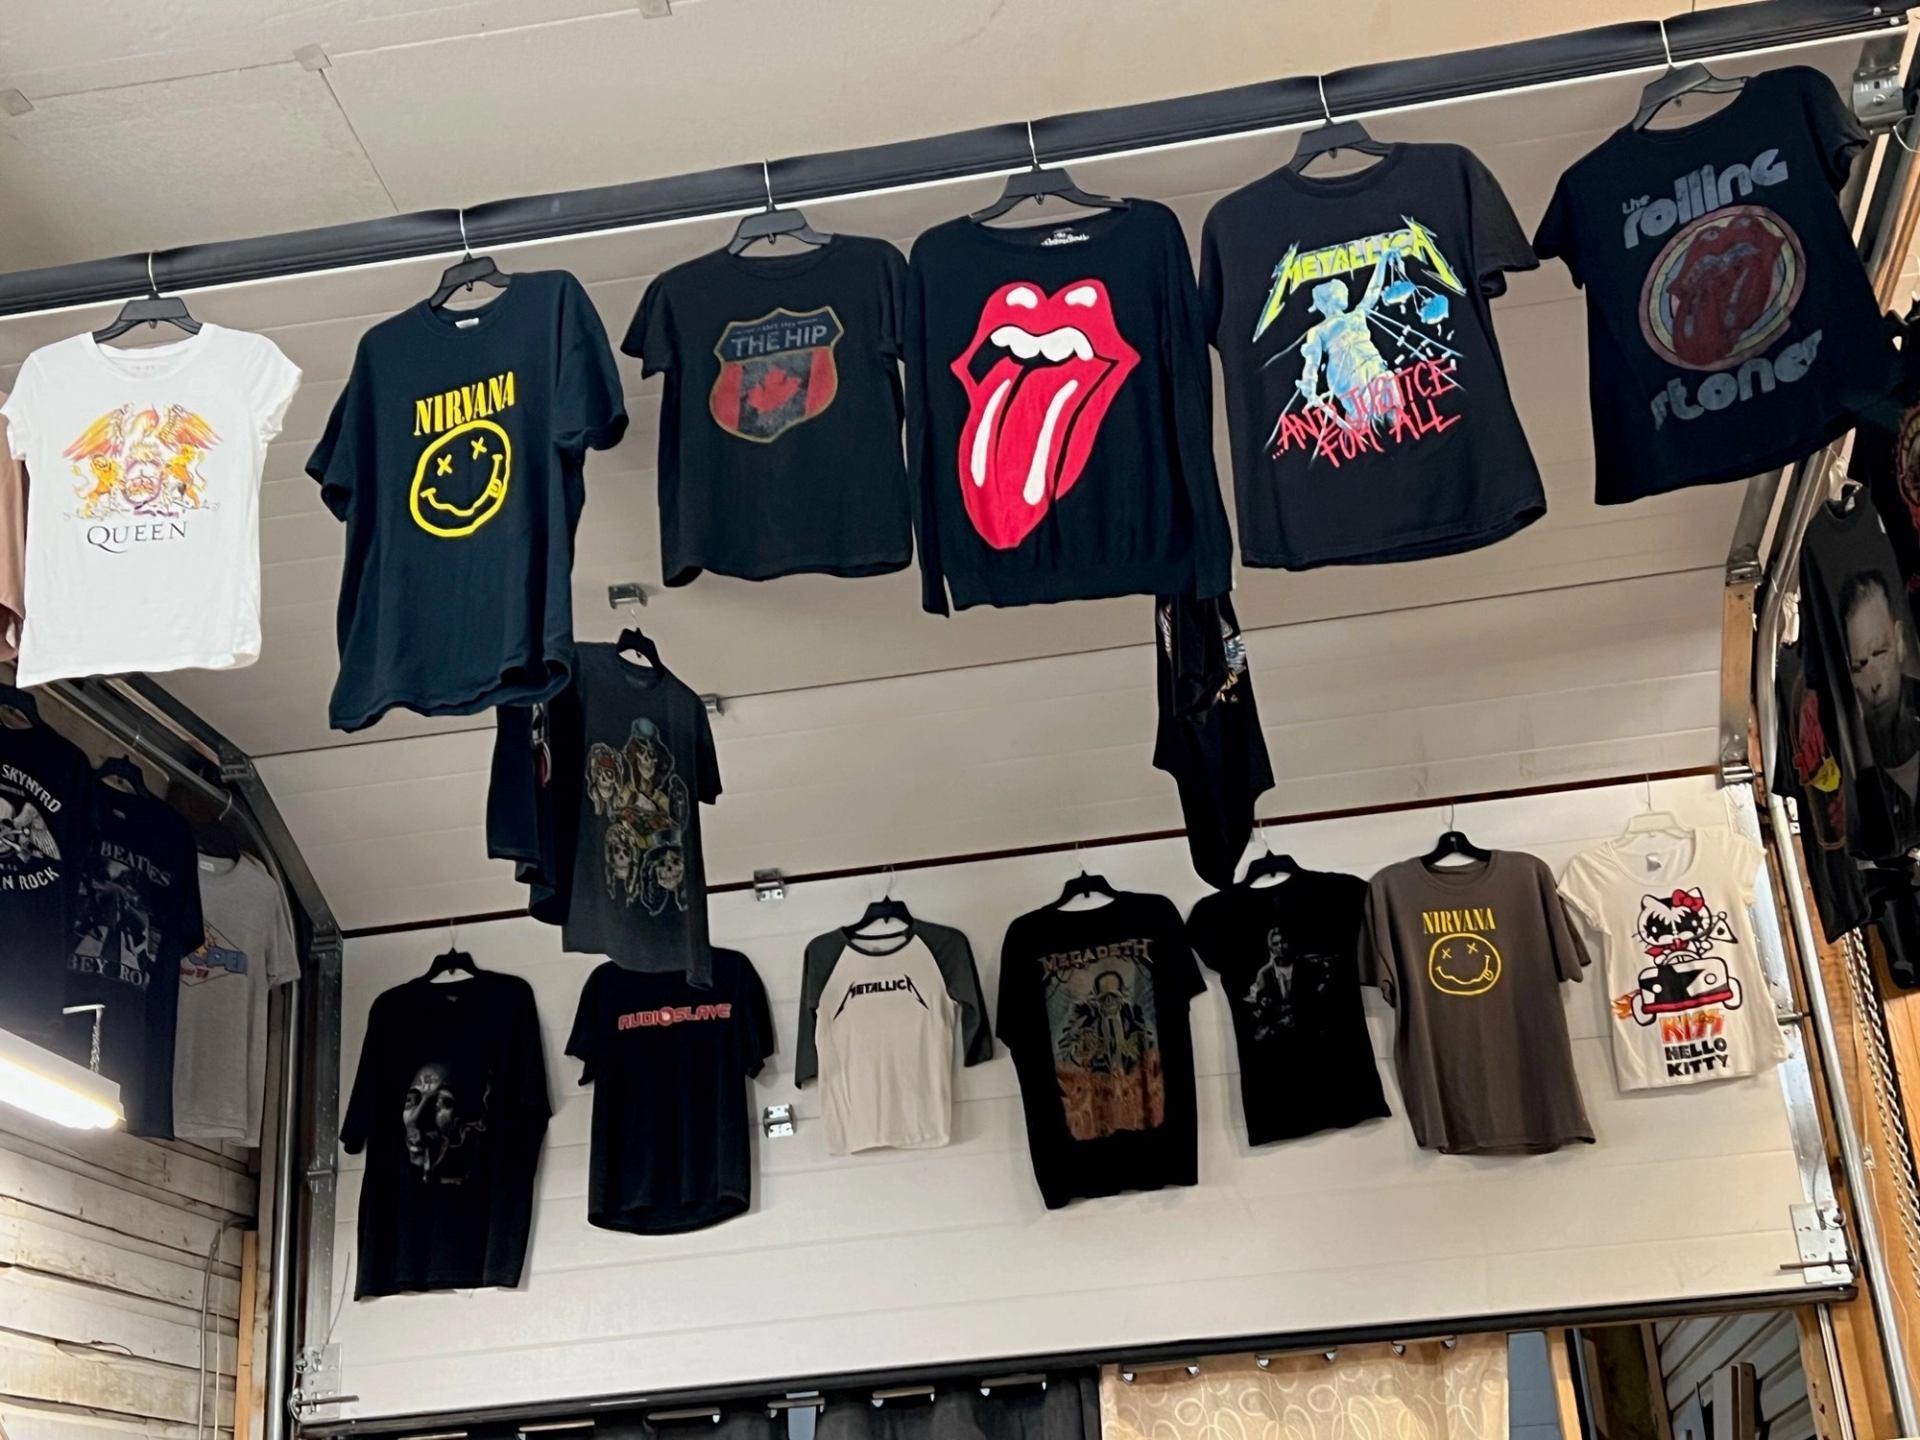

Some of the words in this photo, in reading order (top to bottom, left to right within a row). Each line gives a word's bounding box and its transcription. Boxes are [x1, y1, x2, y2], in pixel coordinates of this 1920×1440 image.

[1252, 214, 1467, 343] METALLICA
[731, 331, 780, 357] THE
[785, 325, 827, 349] HIP
[413, 371, 515, 436] NIRVANA
[1320, 420, 1385, 468] FOR
[1388, 399, 1462, 443] ALL
[86, 521, 189, 554] QUEEN
[1, 764, 62, 813] SKYNYRD
[19, 866, 60, 890] ROCK
[1422, 907, 1496, 934] NIRVANA
[1036, 938, 1154, 982] MEGADETH
[833, 974, 929, 1021] METALLICA
[618, 1003, 732, 1030] AUDIOSLAVE
[1665, 1037, 1727, 1061] HELLO
[1667, 1054, 1728, 1077] KITTY
